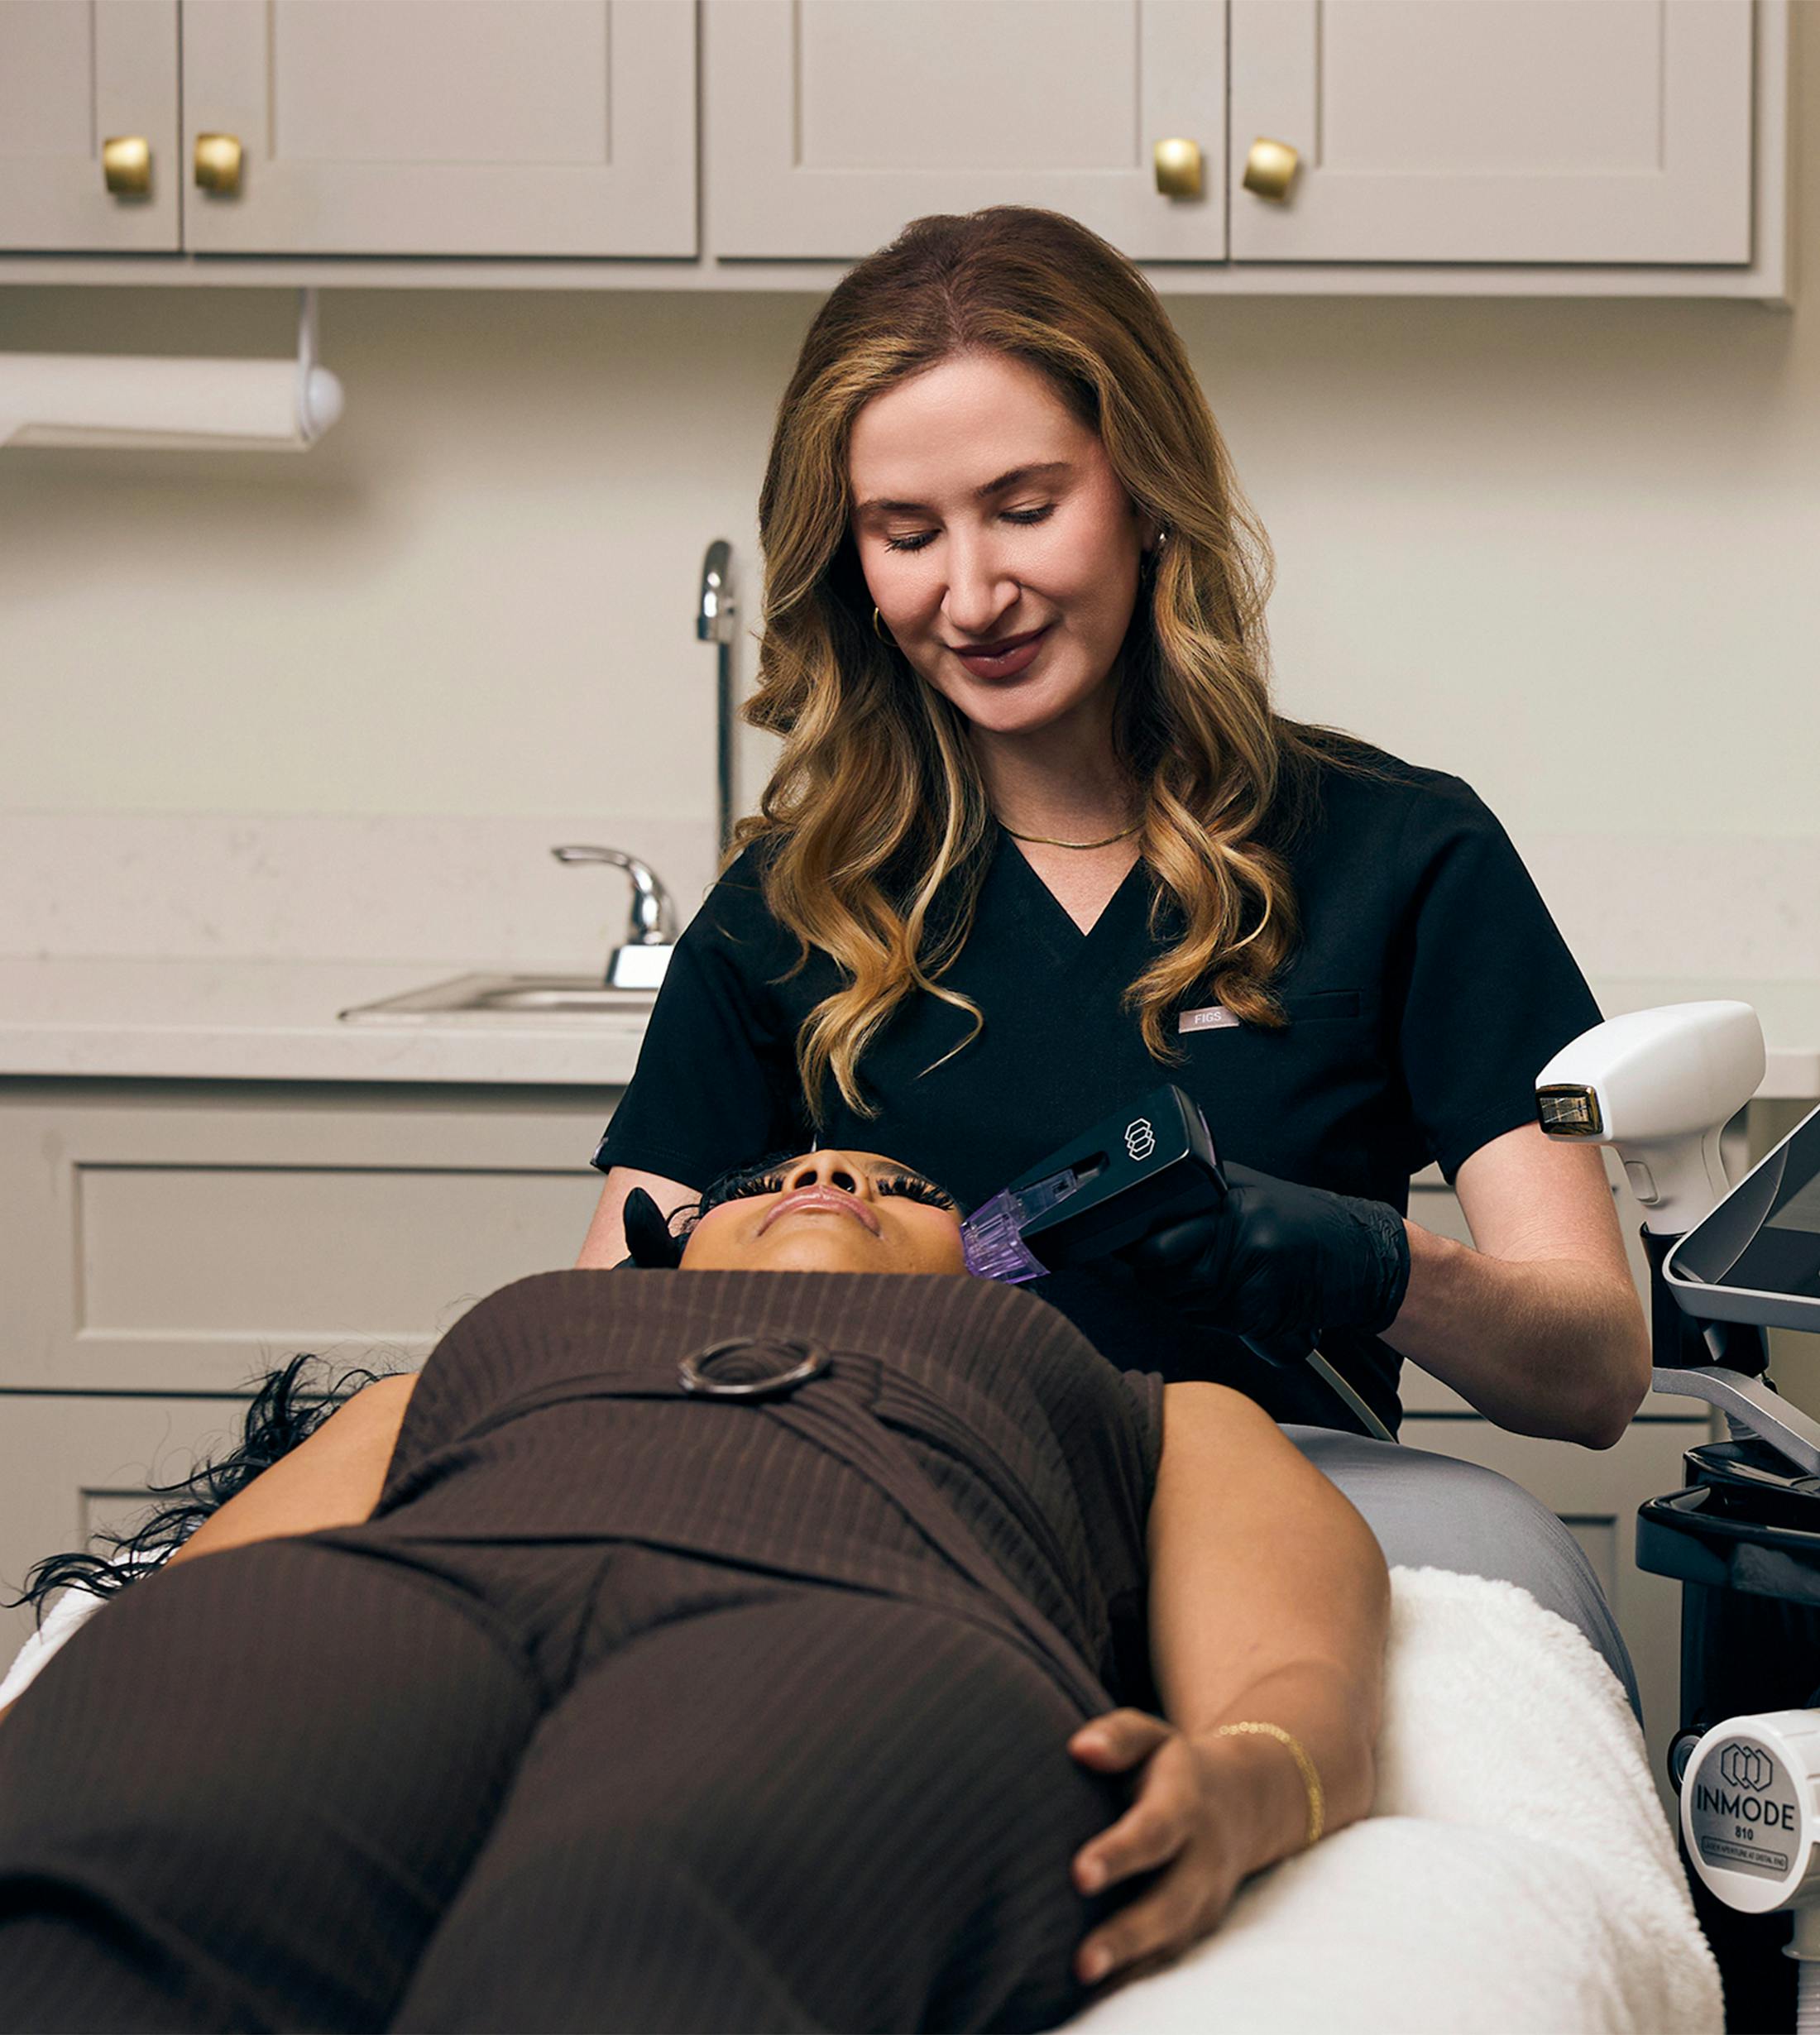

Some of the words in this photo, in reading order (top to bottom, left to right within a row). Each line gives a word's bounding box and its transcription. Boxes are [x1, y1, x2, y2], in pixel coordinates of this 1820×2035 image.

[1195, 1011, 1222, 1024] FIGS
[1697, 1784, 1795, 1831] INMODE
[1735, 1826, 1754, 1841] 810
